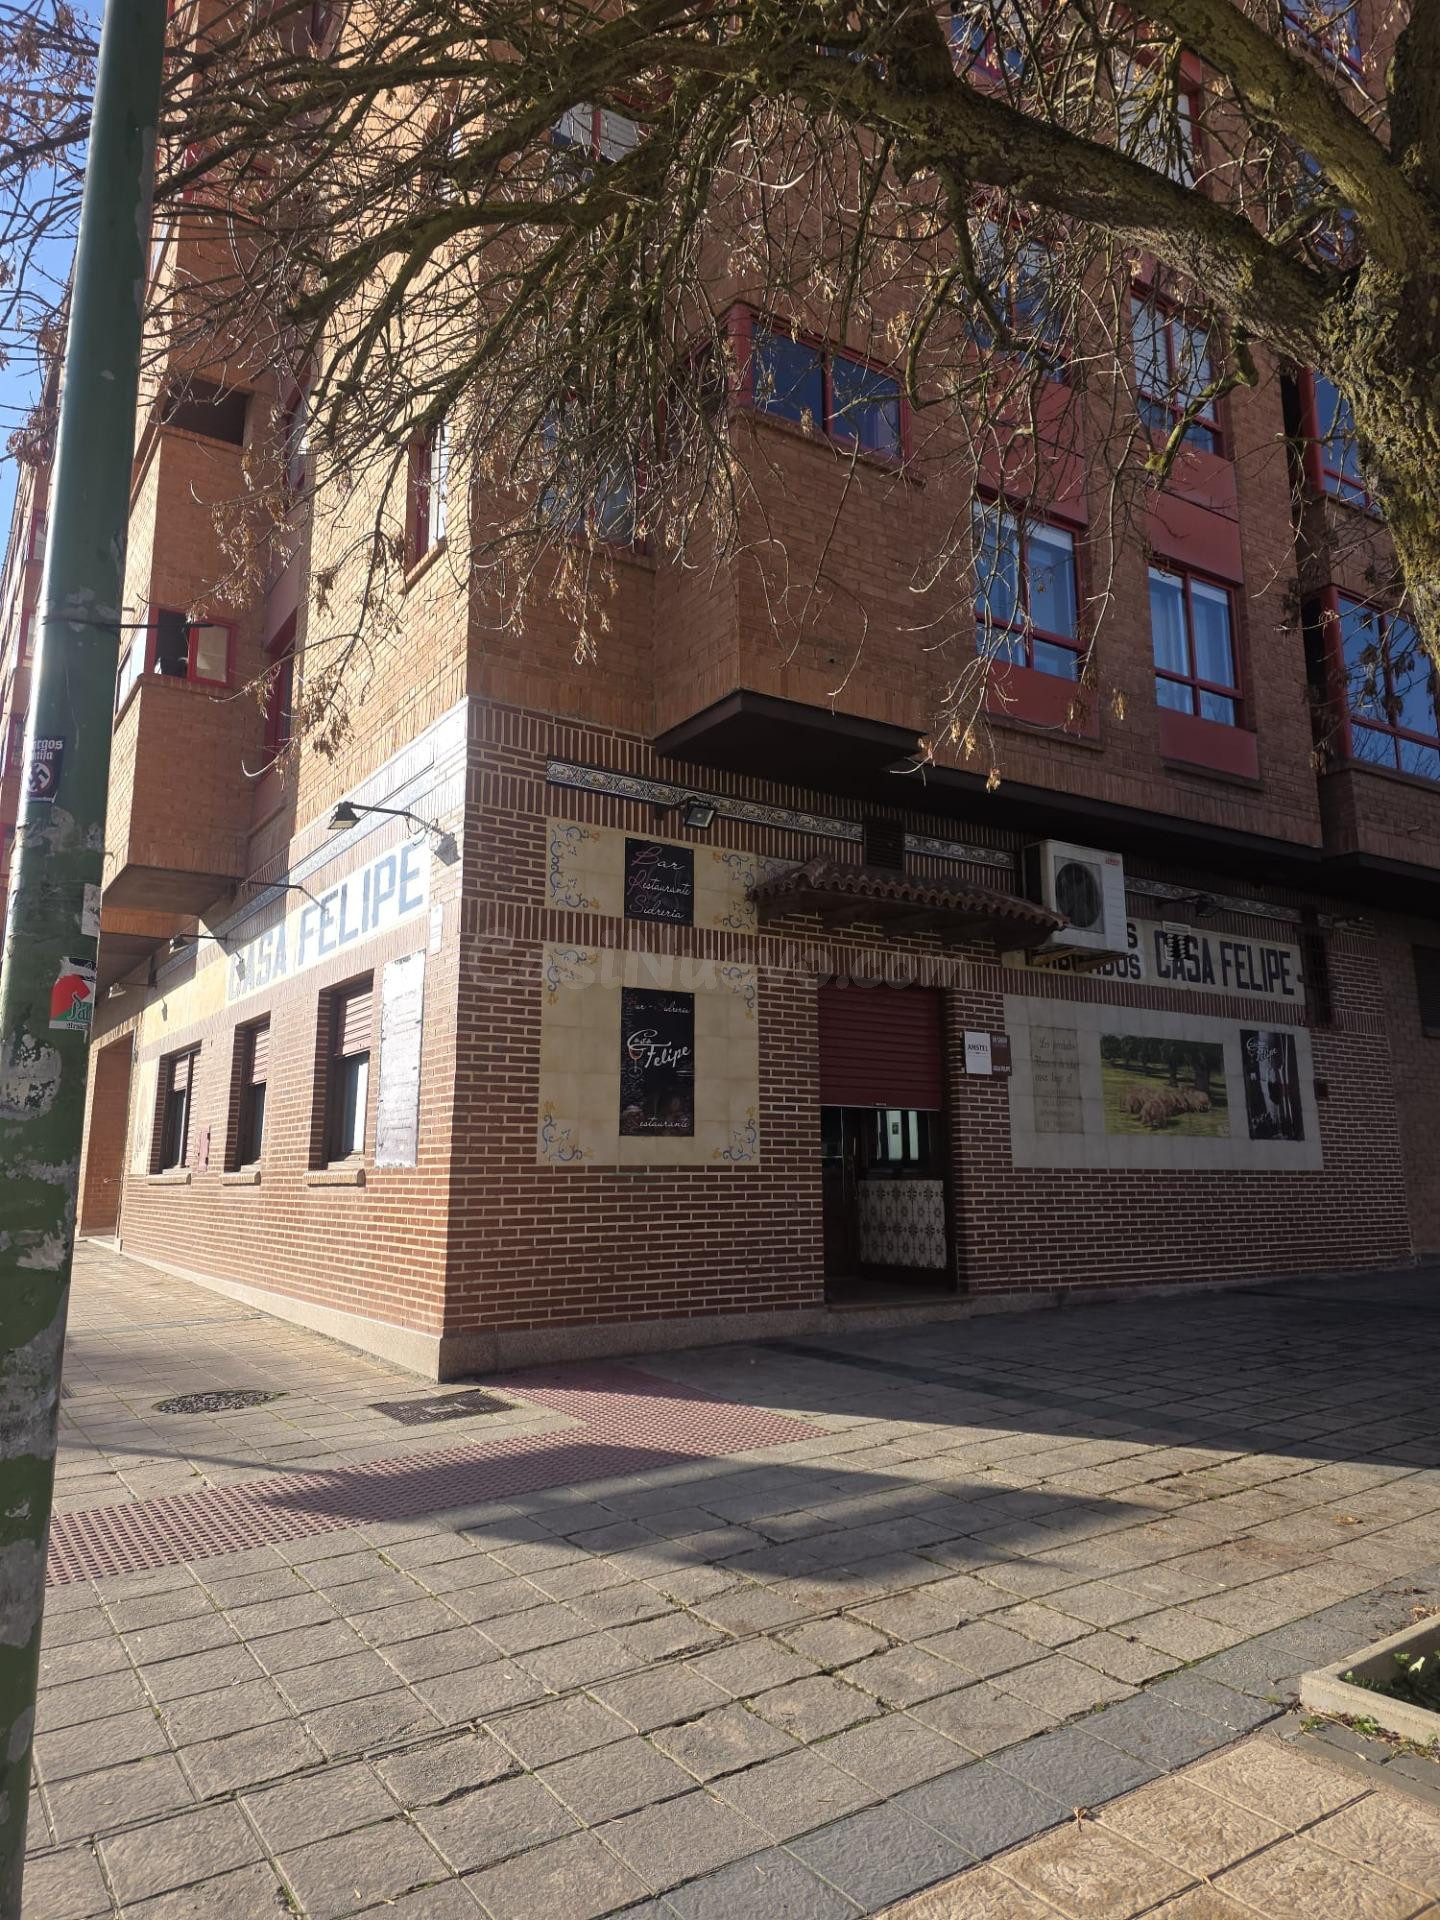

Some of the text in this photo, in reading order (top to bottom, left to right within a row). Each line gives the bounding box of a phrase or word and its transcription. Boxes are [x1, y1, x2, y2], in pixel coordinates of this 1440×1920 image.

[631, 846, 685, 870] Bar
[627, 870, 692, 896] Restaurante
[298, 841, 424, 967] FELIPE
[1153, 929, 1216, 985] CASA
[1219, 940, 1295, 996] FELIPE
[644, 1041, 691, 1068] Felipe
[967, 1043, 988, 1052] AMSTEL
